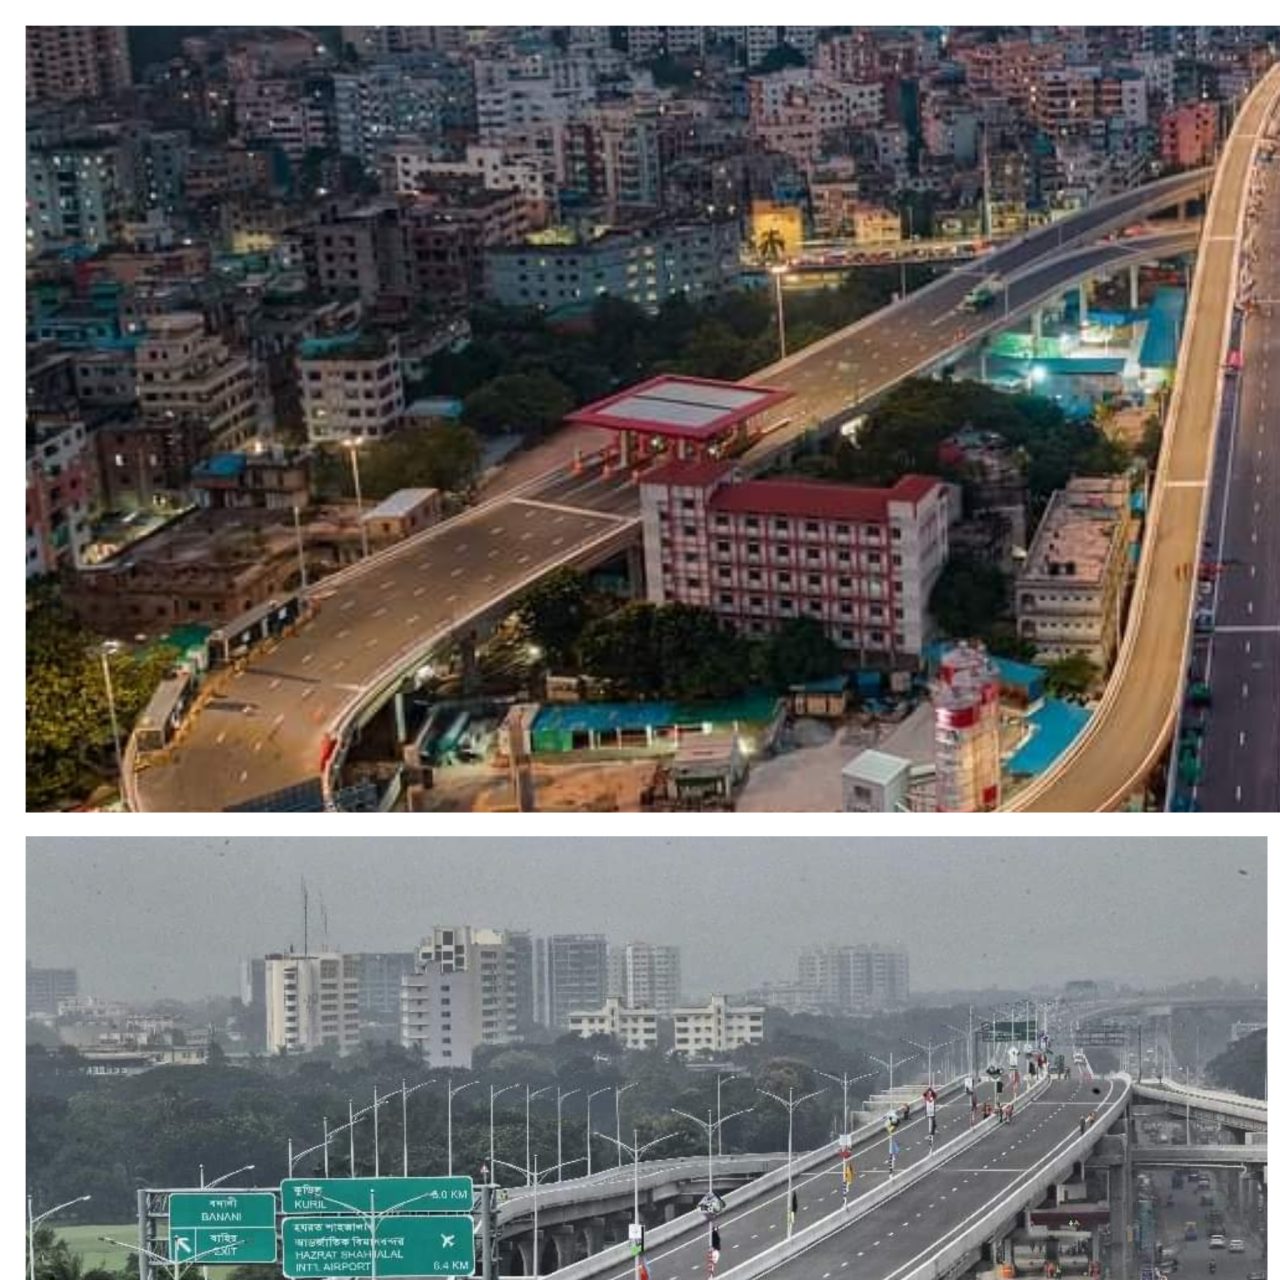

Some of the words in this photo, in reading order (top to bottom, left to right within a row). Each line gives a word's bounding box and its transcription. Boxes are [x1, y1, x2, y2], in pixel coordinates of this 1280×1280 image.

[451, 1190, 468, 1199] KM
[294, 1200, 327, 1209] KURIL
[201, 1212, 242, 1221] BANANI
[296, 1251, 338, 1260] HAZRAT
[341, 1250, 404, 1259] SHAHALAL
[323, 1262, 372, 1271] AIRPORT
[452, 1261, 469, 1270] KM
